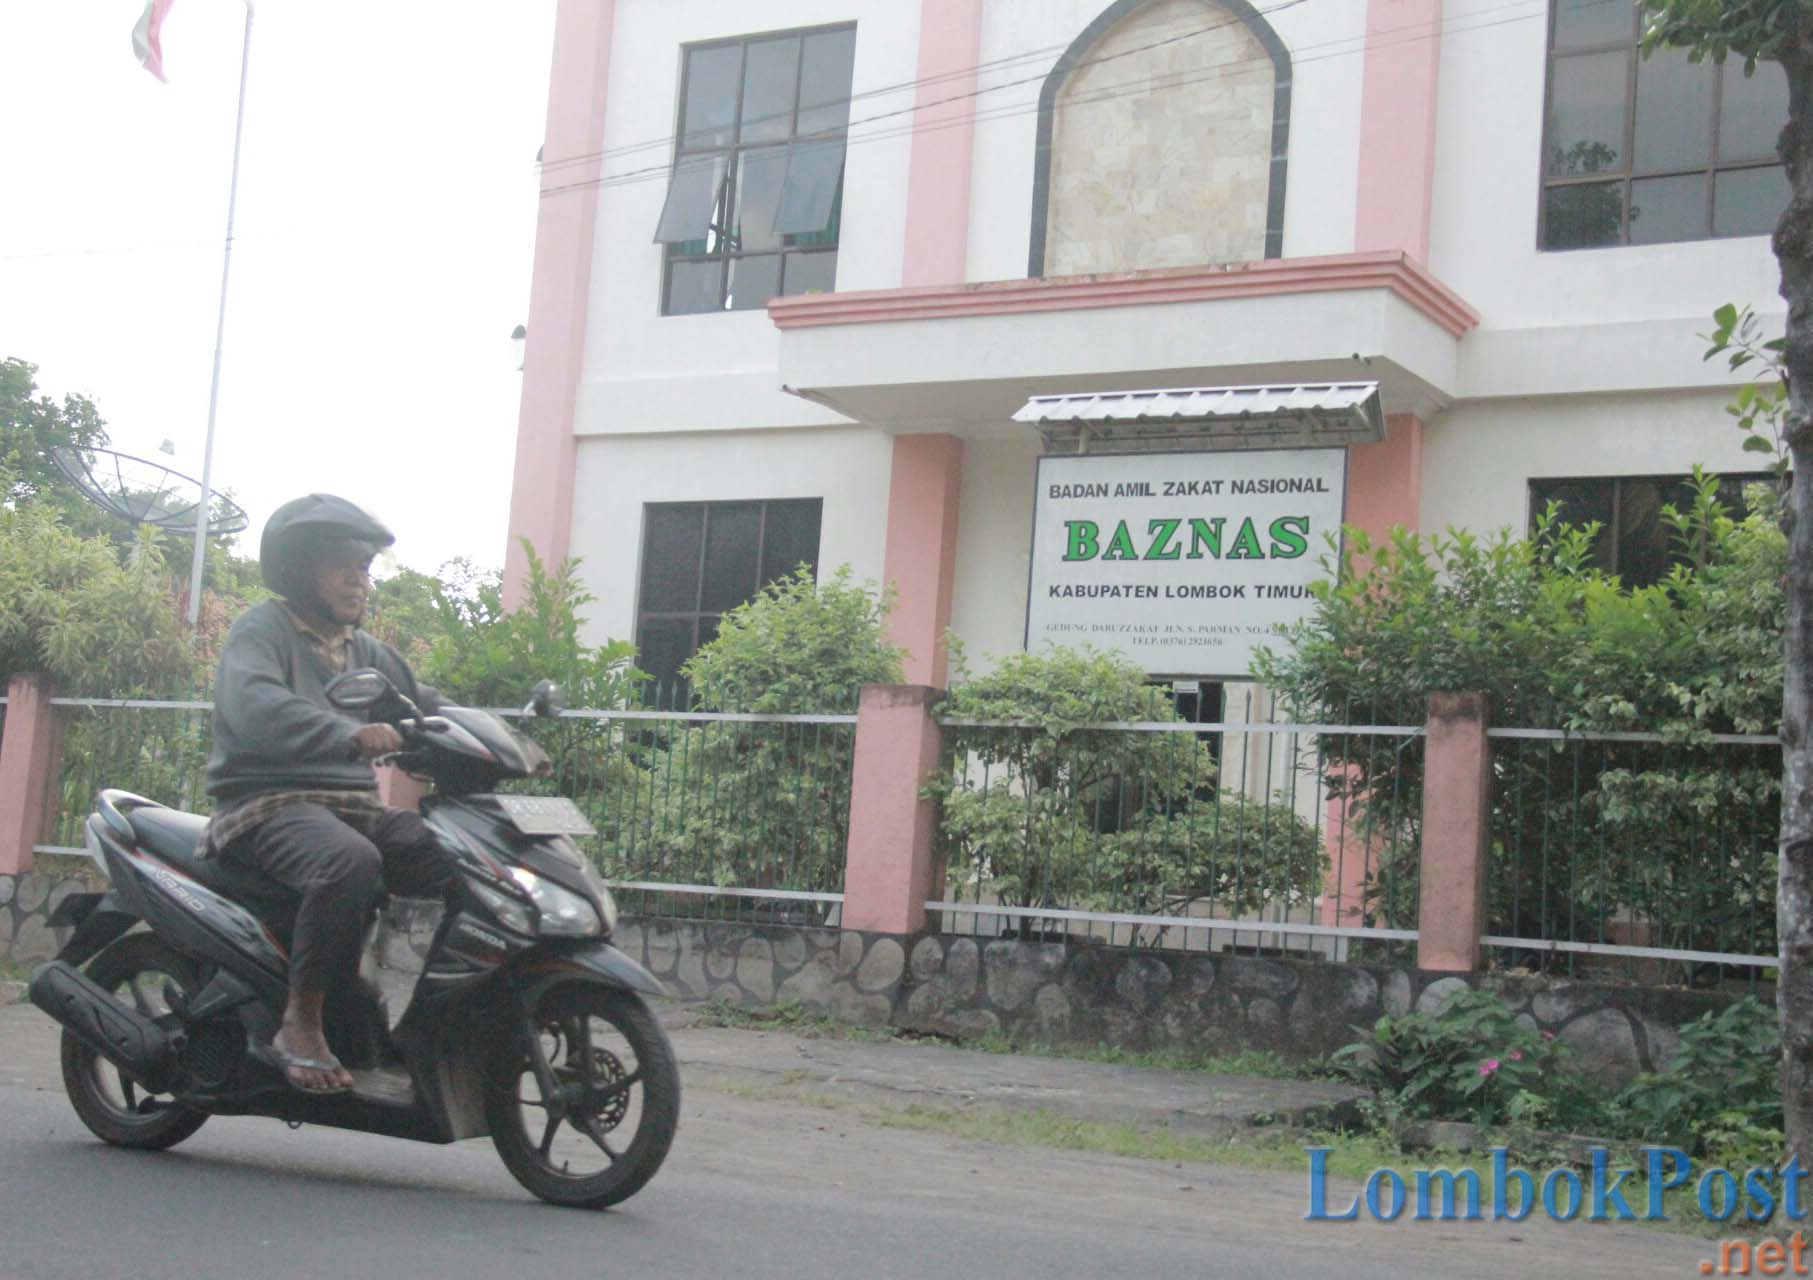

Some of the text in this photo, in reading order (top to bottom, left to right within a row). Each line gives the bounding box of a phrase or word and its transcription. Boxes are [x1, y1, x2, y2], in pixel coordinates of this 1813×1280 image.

[1049, 477, 1330, 499] BADAN AMIL ZAKAT NASIONAL
[1062, 516, 1310, 562] BAZNAS
[1049, 585, 1158, 599] KABUPATEN
[1165, 585, 1246, 599] LOMBOK
